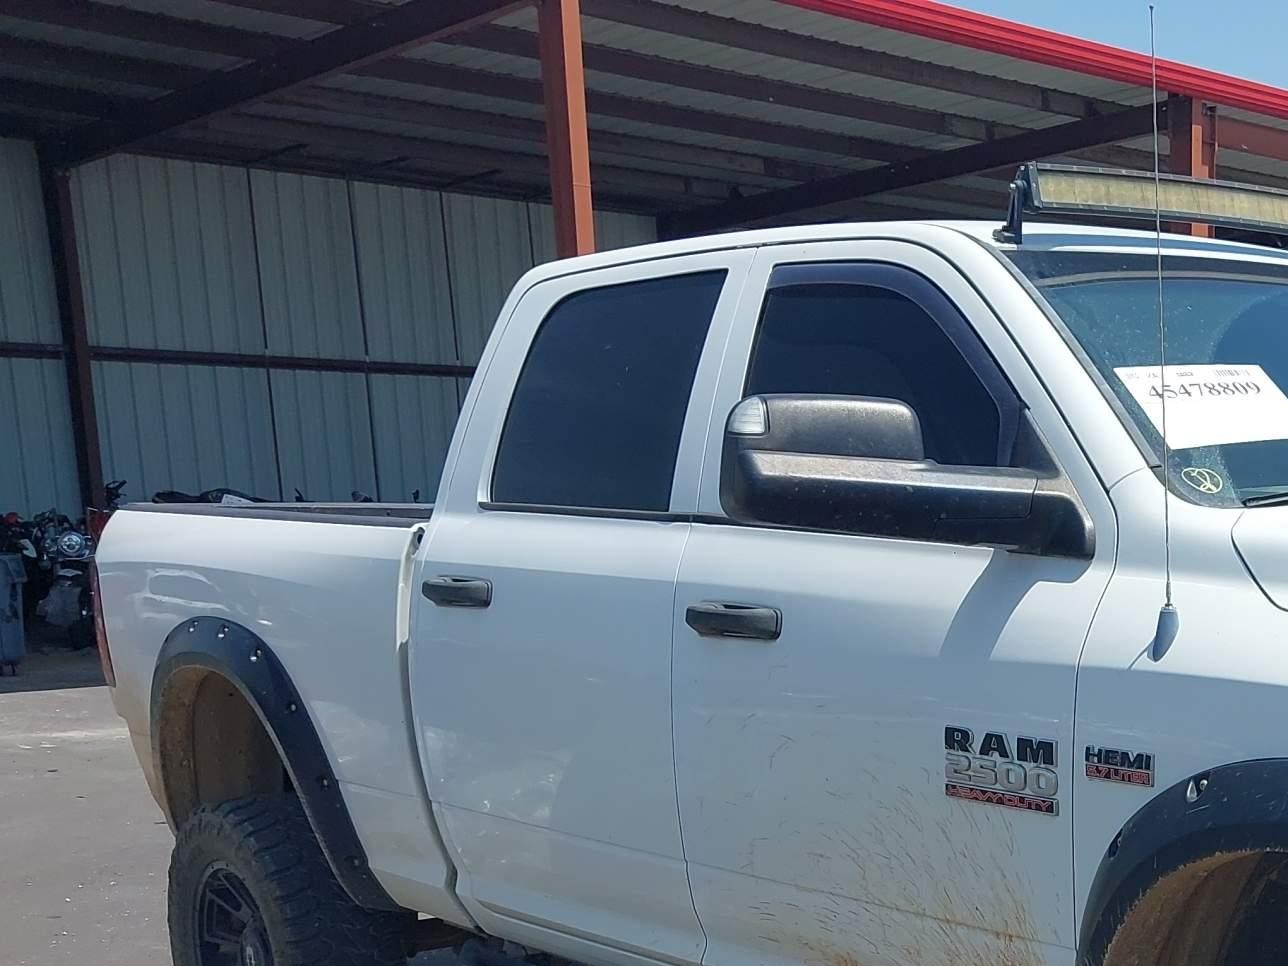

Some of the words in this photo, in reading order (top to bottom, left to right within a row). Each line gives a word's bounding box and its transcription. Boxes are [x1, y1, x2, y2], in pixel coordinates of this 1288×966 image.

[1149, 381, 1261, 399] 45478809
[945, 725, 1058, 767] RAM
[1085, 745, 1154, 771] HEMI
[945, 753, 1059, 796] 2500
[1110, 769, 1149, 785] LITER
[946, 784, 1001, 803] HEAVY
[1002, 795, 1051, 812] DUTY
